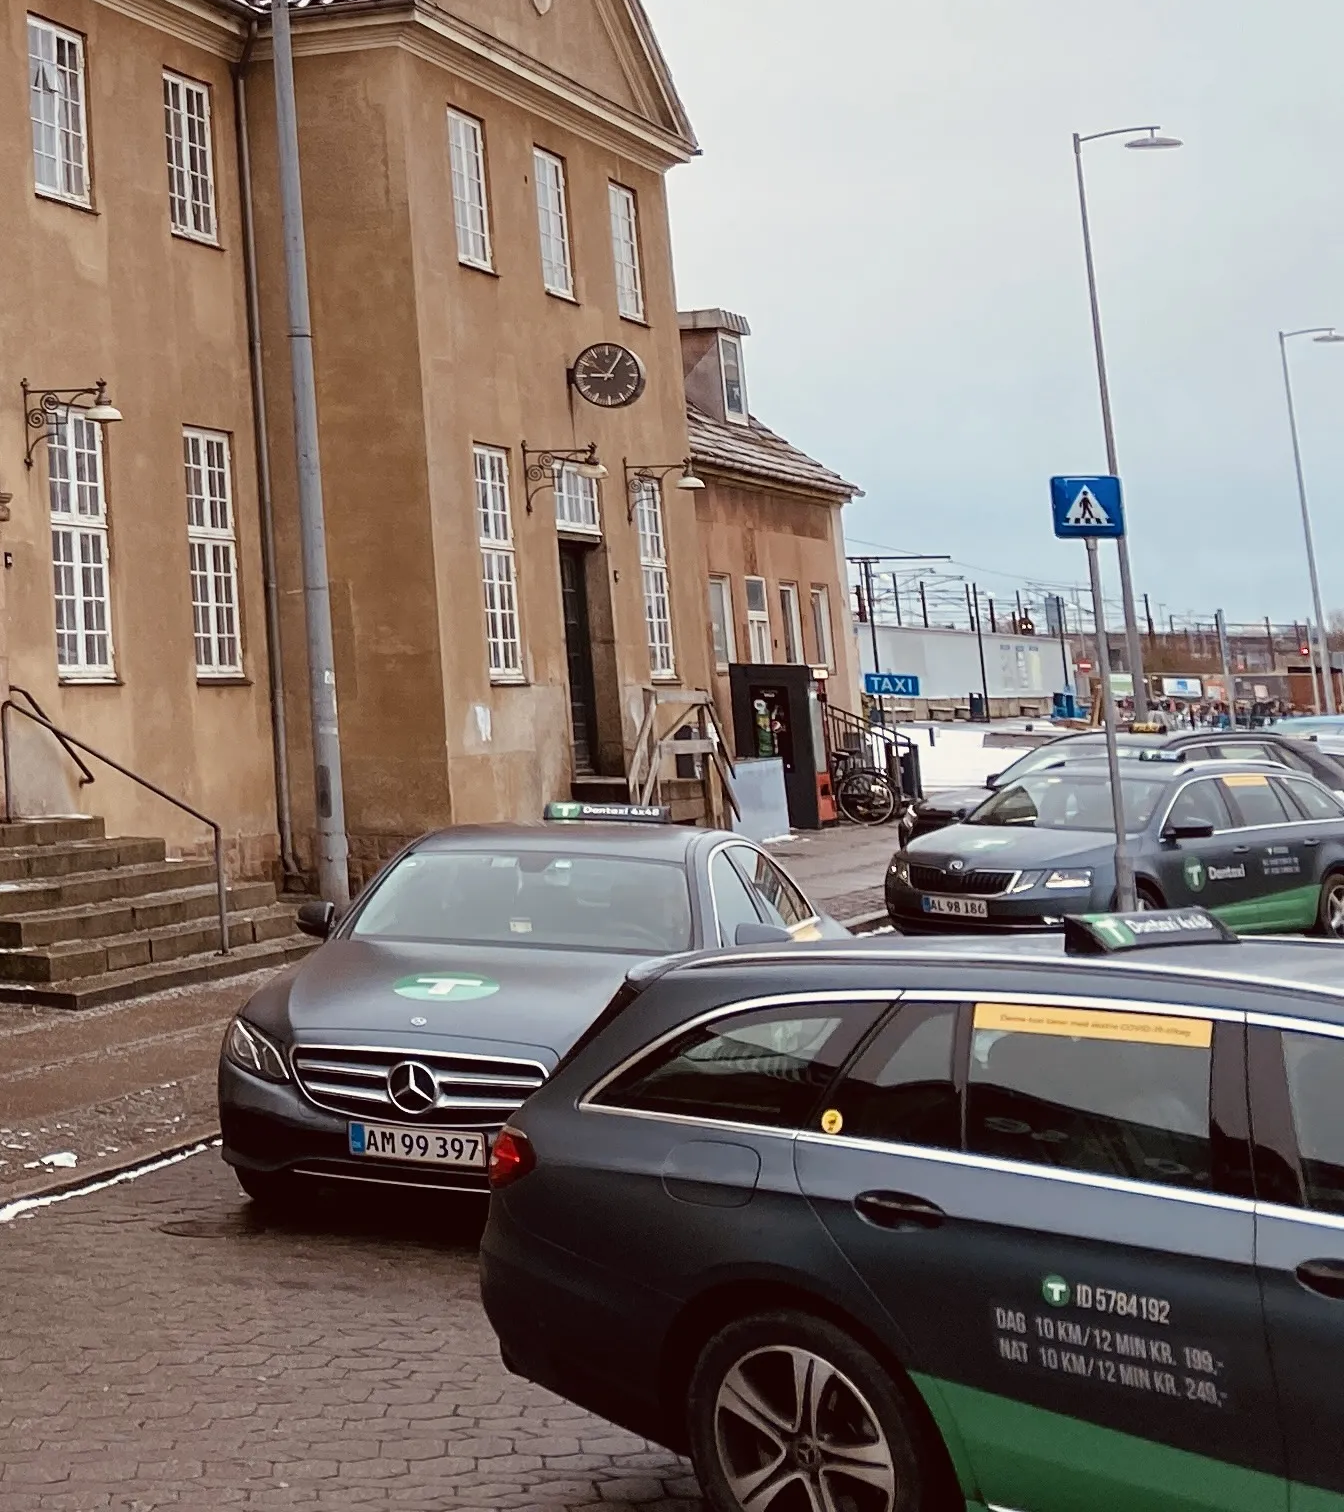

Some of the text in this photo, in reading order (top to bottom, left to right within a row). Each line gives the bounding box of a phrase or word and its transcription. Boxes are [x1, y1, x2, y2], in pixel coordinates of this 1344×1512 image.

[870, 676, 913, 693] TAXI
[582, 805, 628, 816] Dantaxi
[631, 807, 660, 817] 4x48
[931, 899, 944, 912] AL
[946, 900, 961, 913] 98
[366, 1129, 479, 1161] AM 99 397
[1076, 1283, 1092, 1309] ID
[1095, 1287, 1171, 1326] 5784192
[994, 1307, 1027, 1334] DAG
[1035, 1316, 1055, 1340] 10
[1115, 1331, 1148, 1360] MIN
[1149, 1339, 1178, 1367] KR.
[999, 1338, 1029, 1364] NAT
[1039, 1345, 1059, 1370] 10
[1119, 1363, 1152, 1390] MIN
[1153, 1370, 1182, 1398] KR.
